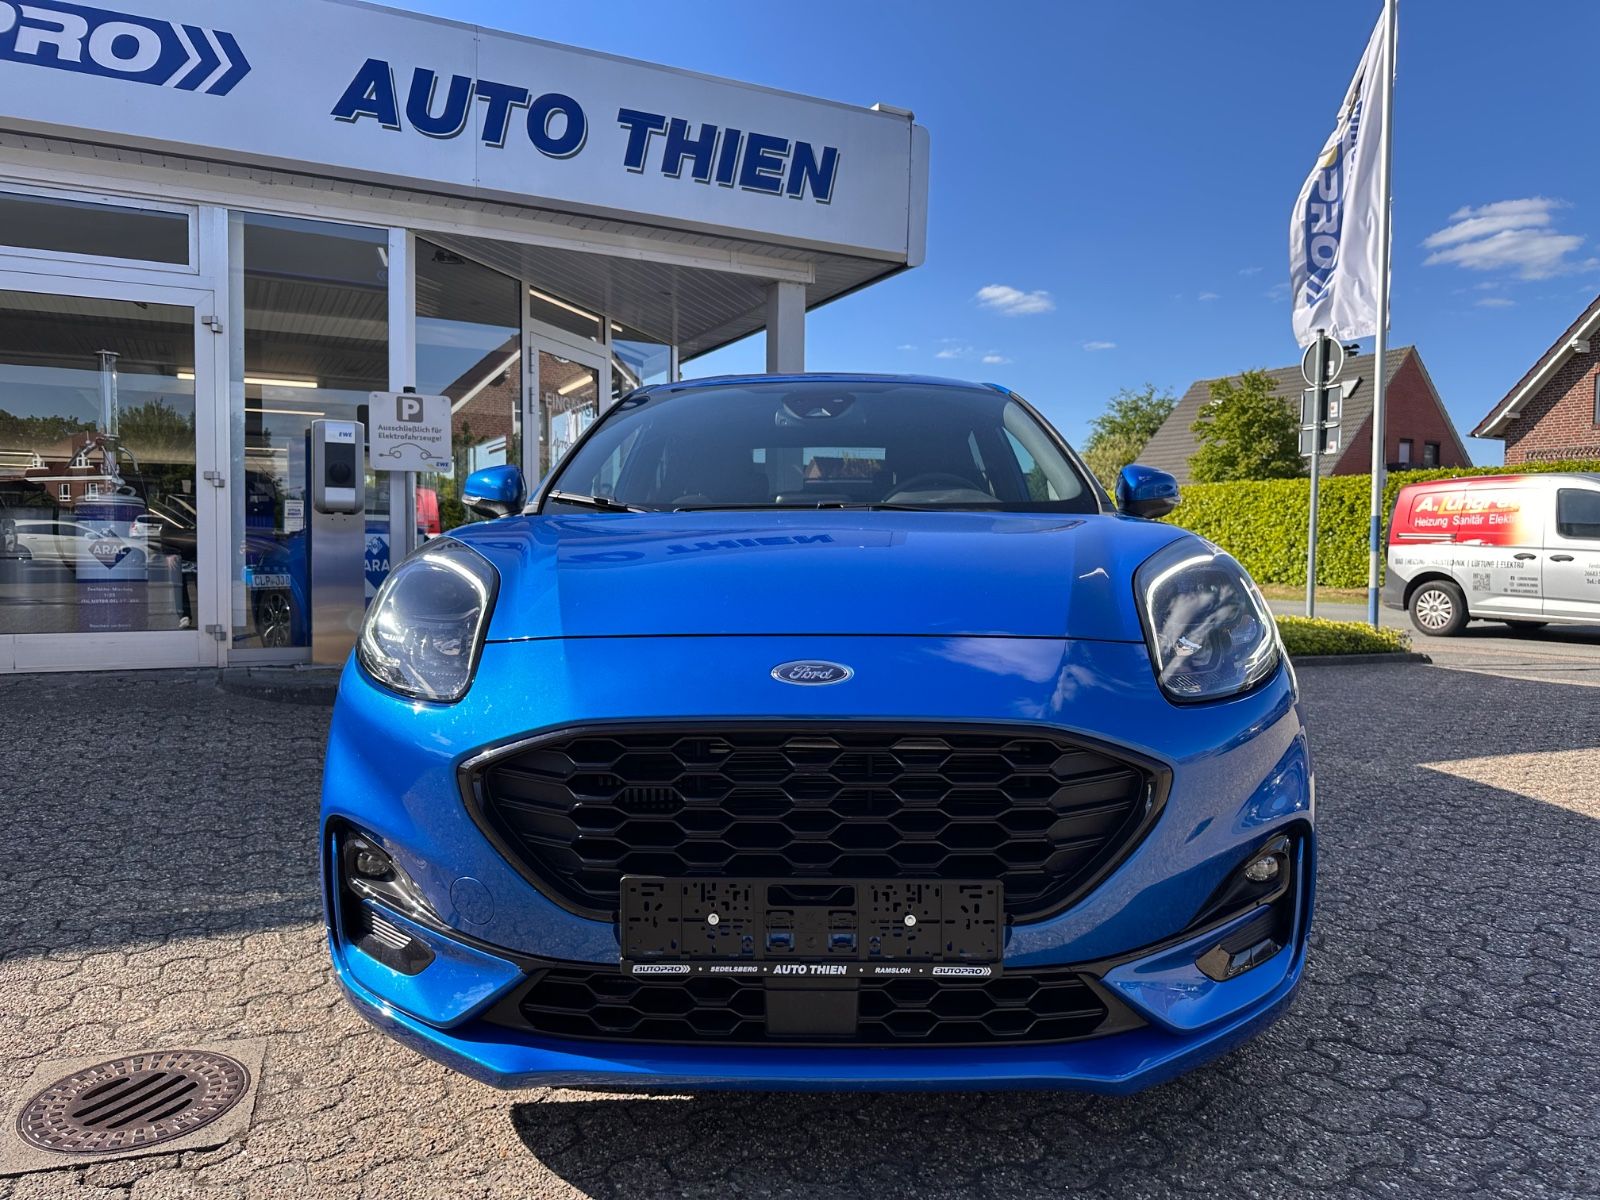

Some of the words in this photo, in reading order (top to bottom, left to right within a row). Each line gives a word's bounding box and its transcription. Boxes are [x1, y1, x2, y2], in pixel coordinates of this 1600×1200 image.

[0, 2, 162, 72] RO
[330, 57, 588, 158] AUTO
[617, 108, 840, 204] THIEN
[402, 399, 420, 420] P
[378, 425, 430, 433] Ausschließlich
[378, 433, 442, 442] Elektrofahrzeuge!
[1414, 517, 1448, 528] Heizung
[1452, 515, 1484, 525] Sanitär
[93, 545, 127, 555] ARAL
[789, 664, 833, 679] Ford
[773, 965, 807, 974] AUTO
[809, 965, 847, 975] THIEN
